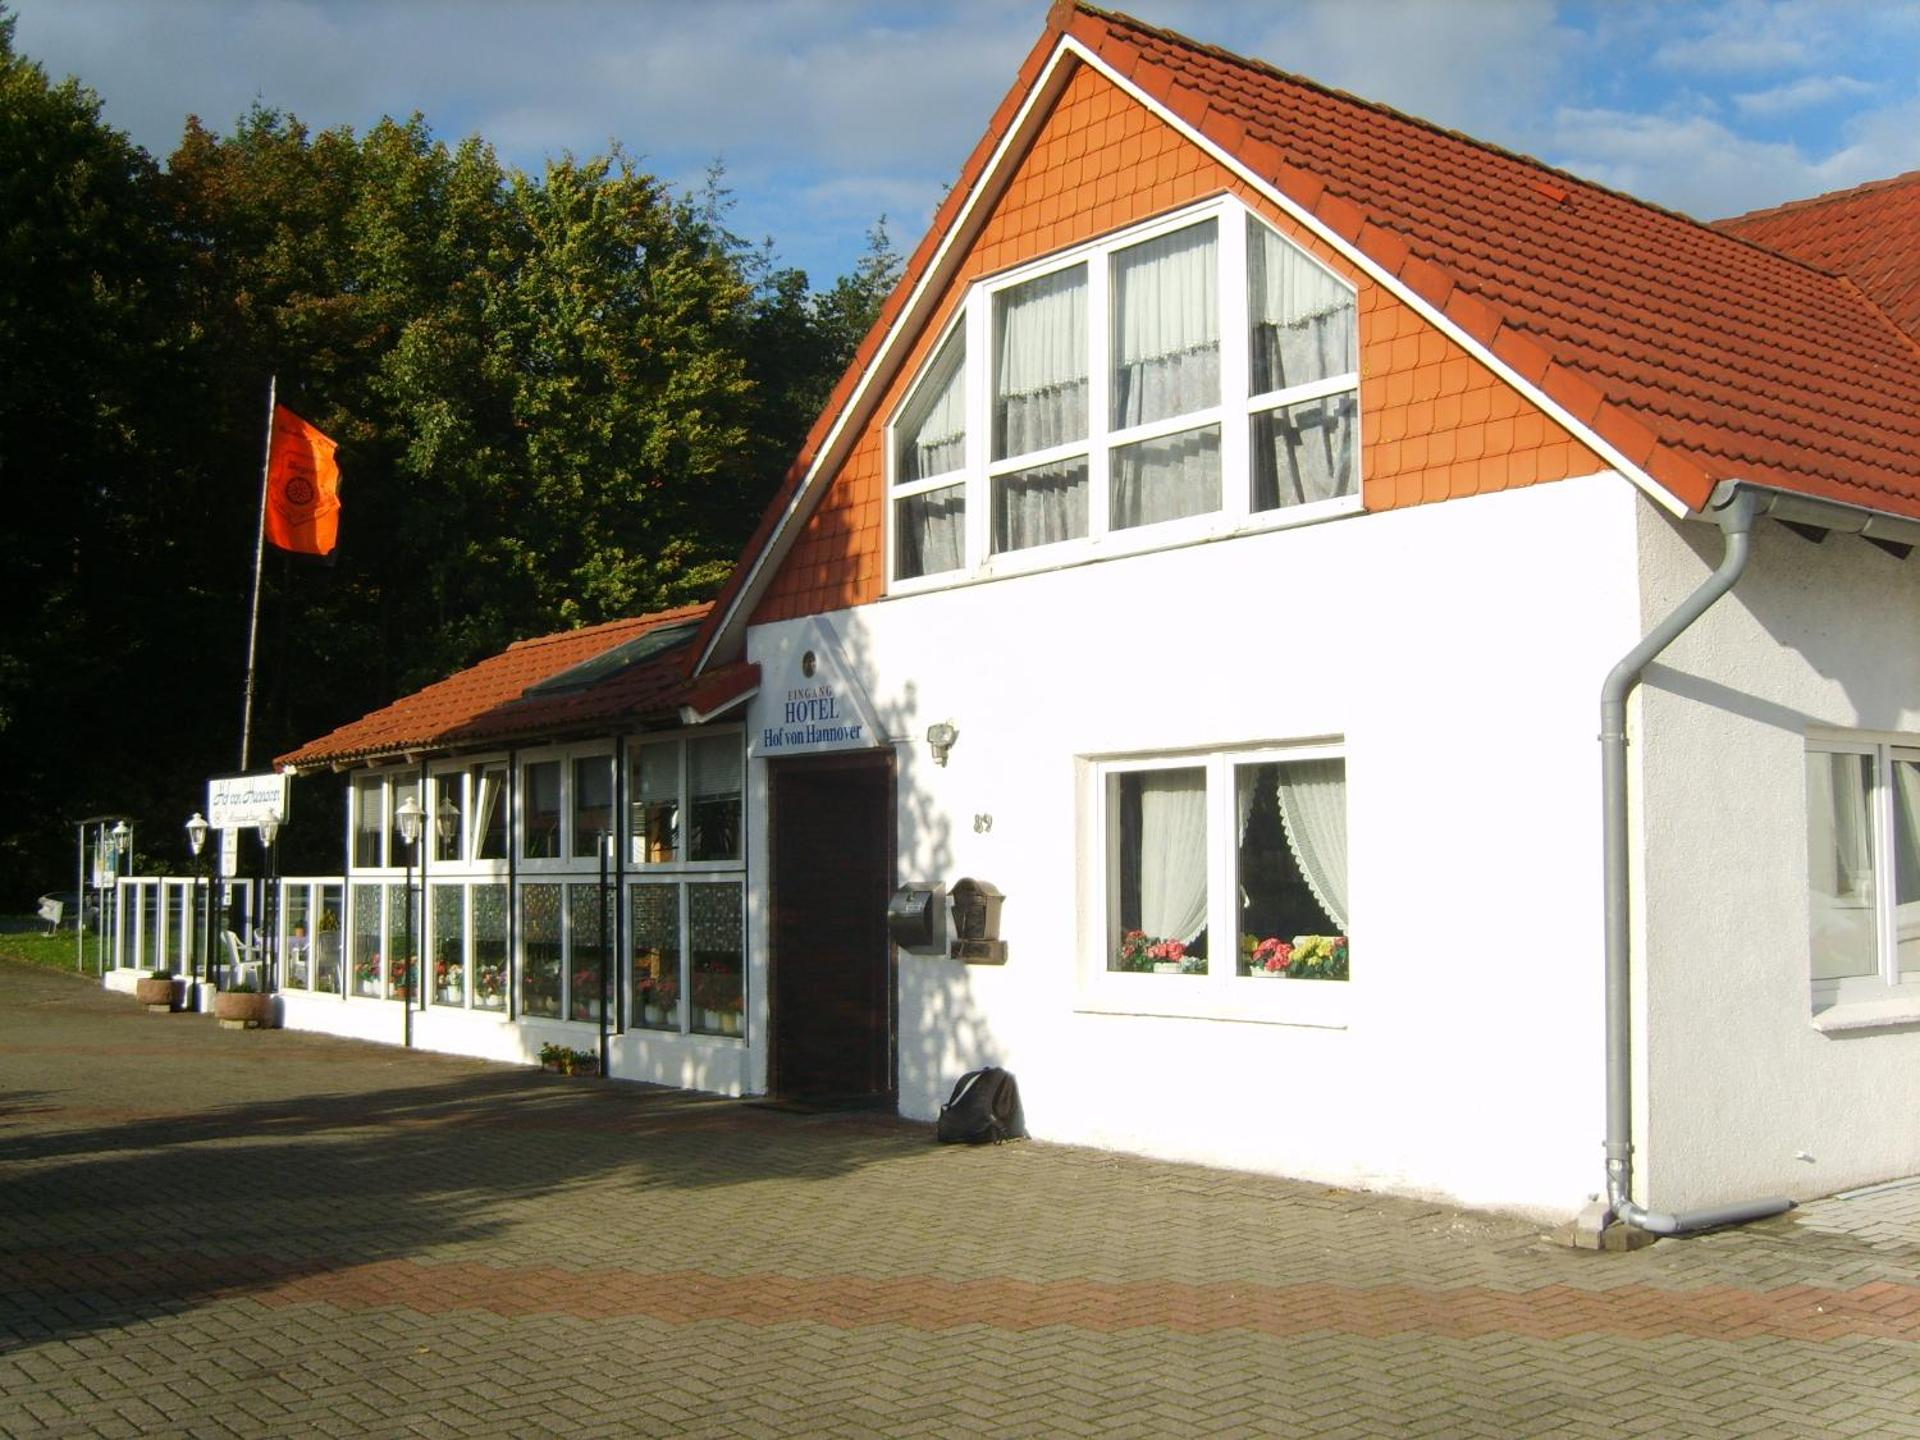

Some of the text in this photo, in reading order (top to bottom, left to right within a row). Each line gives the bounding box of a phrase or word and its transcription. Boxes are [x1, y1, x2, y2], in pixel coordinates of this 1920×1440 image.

[788, 686, 832, 700] EINGANG
[785, 698, 840, 723] HOTEL
[764, 724, 862, 747] Hof von Hannover
